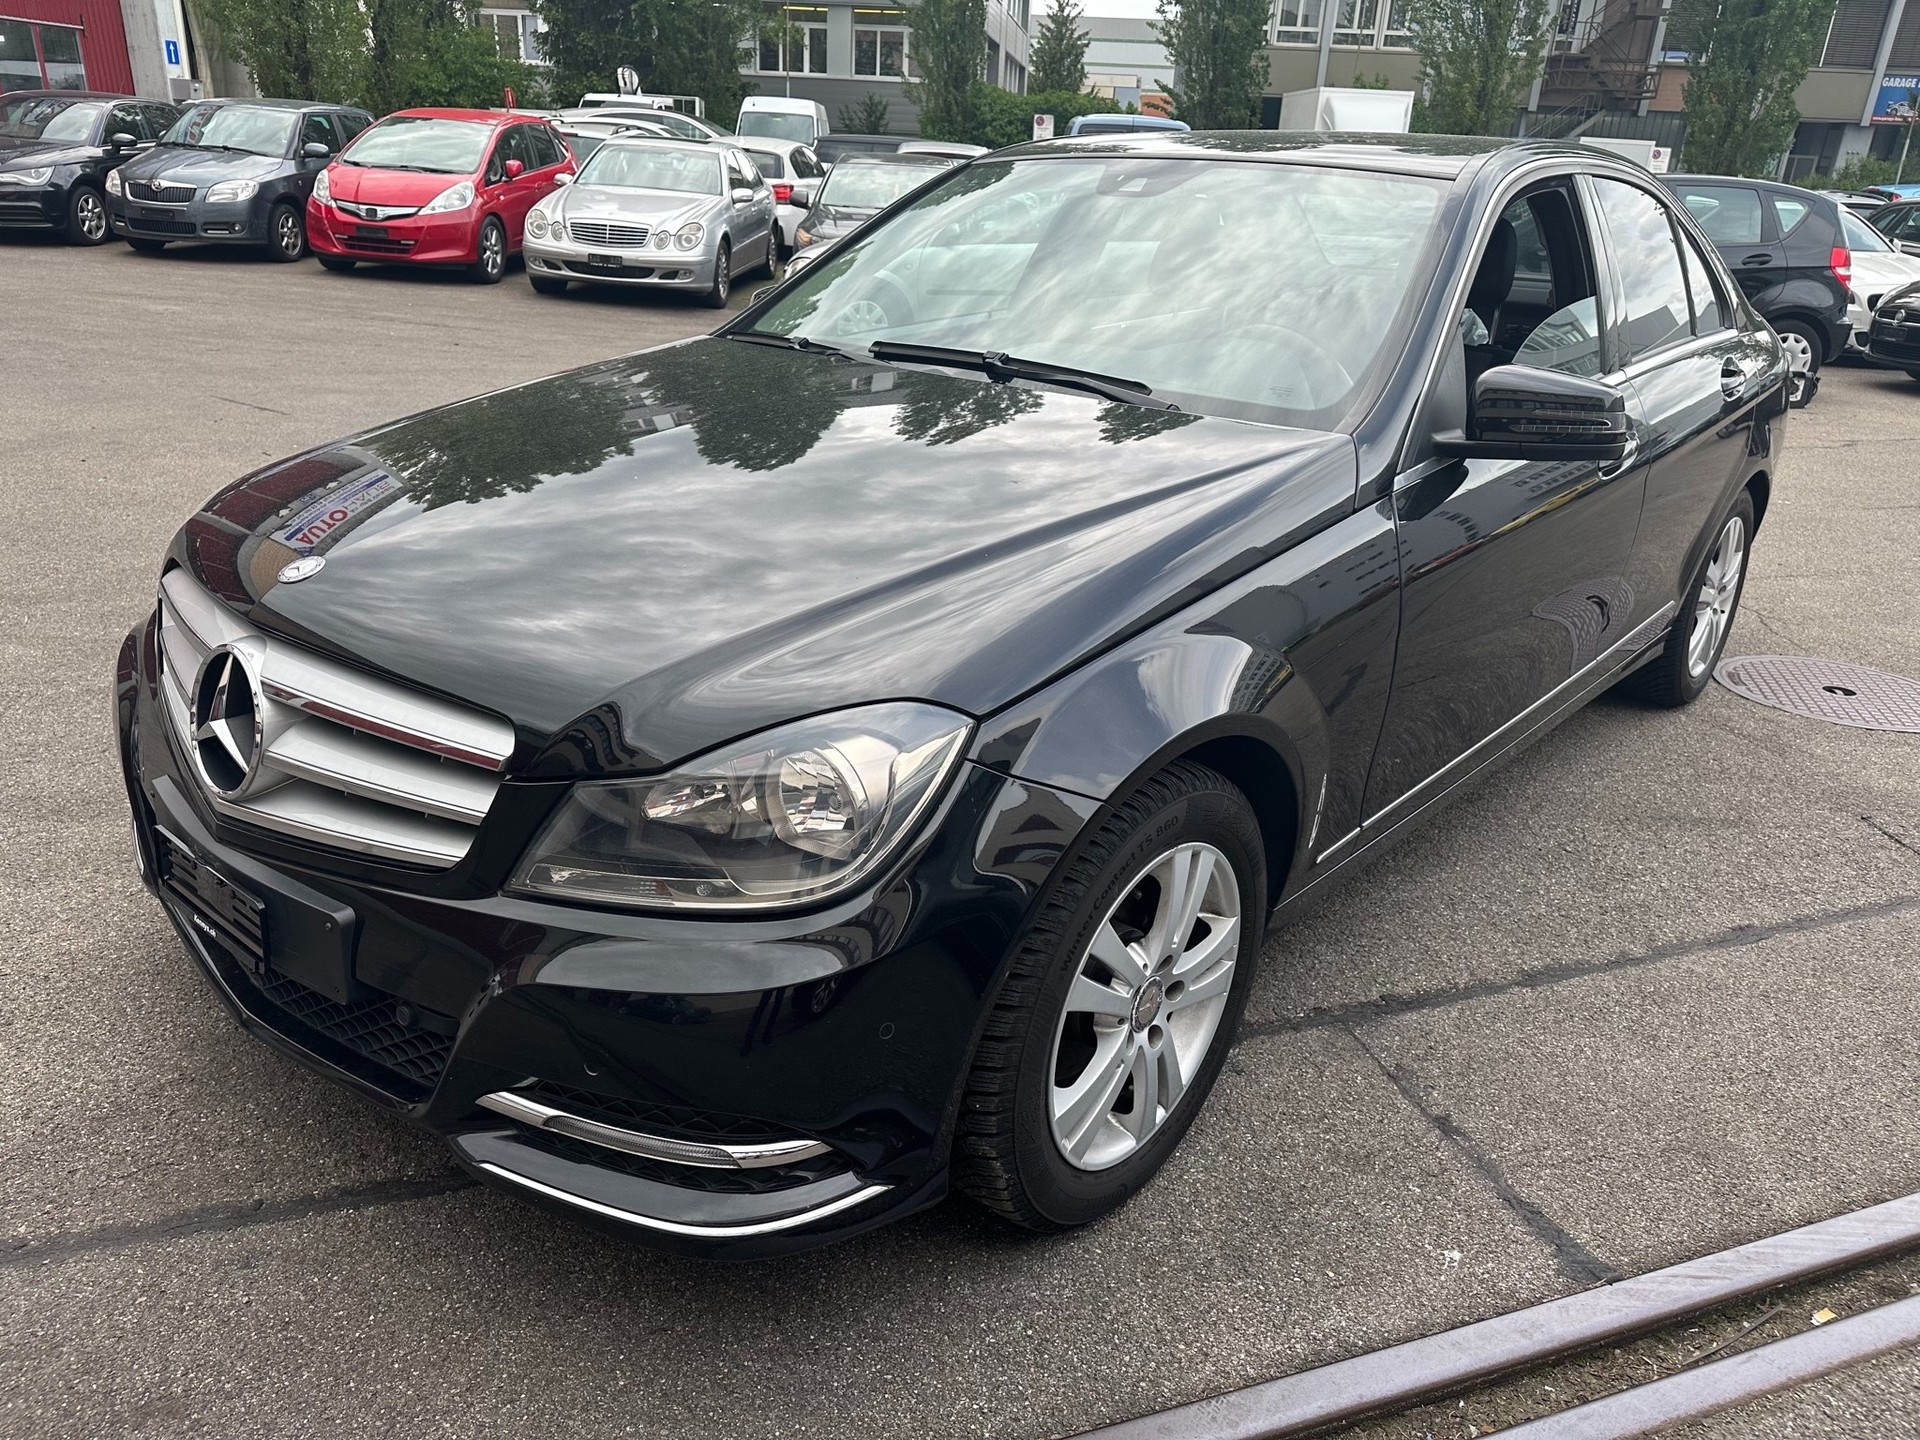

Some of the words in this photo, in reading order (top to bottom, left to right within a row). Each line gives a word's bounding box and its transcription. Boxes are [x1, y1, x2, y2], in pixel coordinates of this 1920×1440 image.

[1882, 77, 1917, 88] GARAGE
[1137, 833, 1153, 851] TS
[1156, 815, 1179, 837] 860
